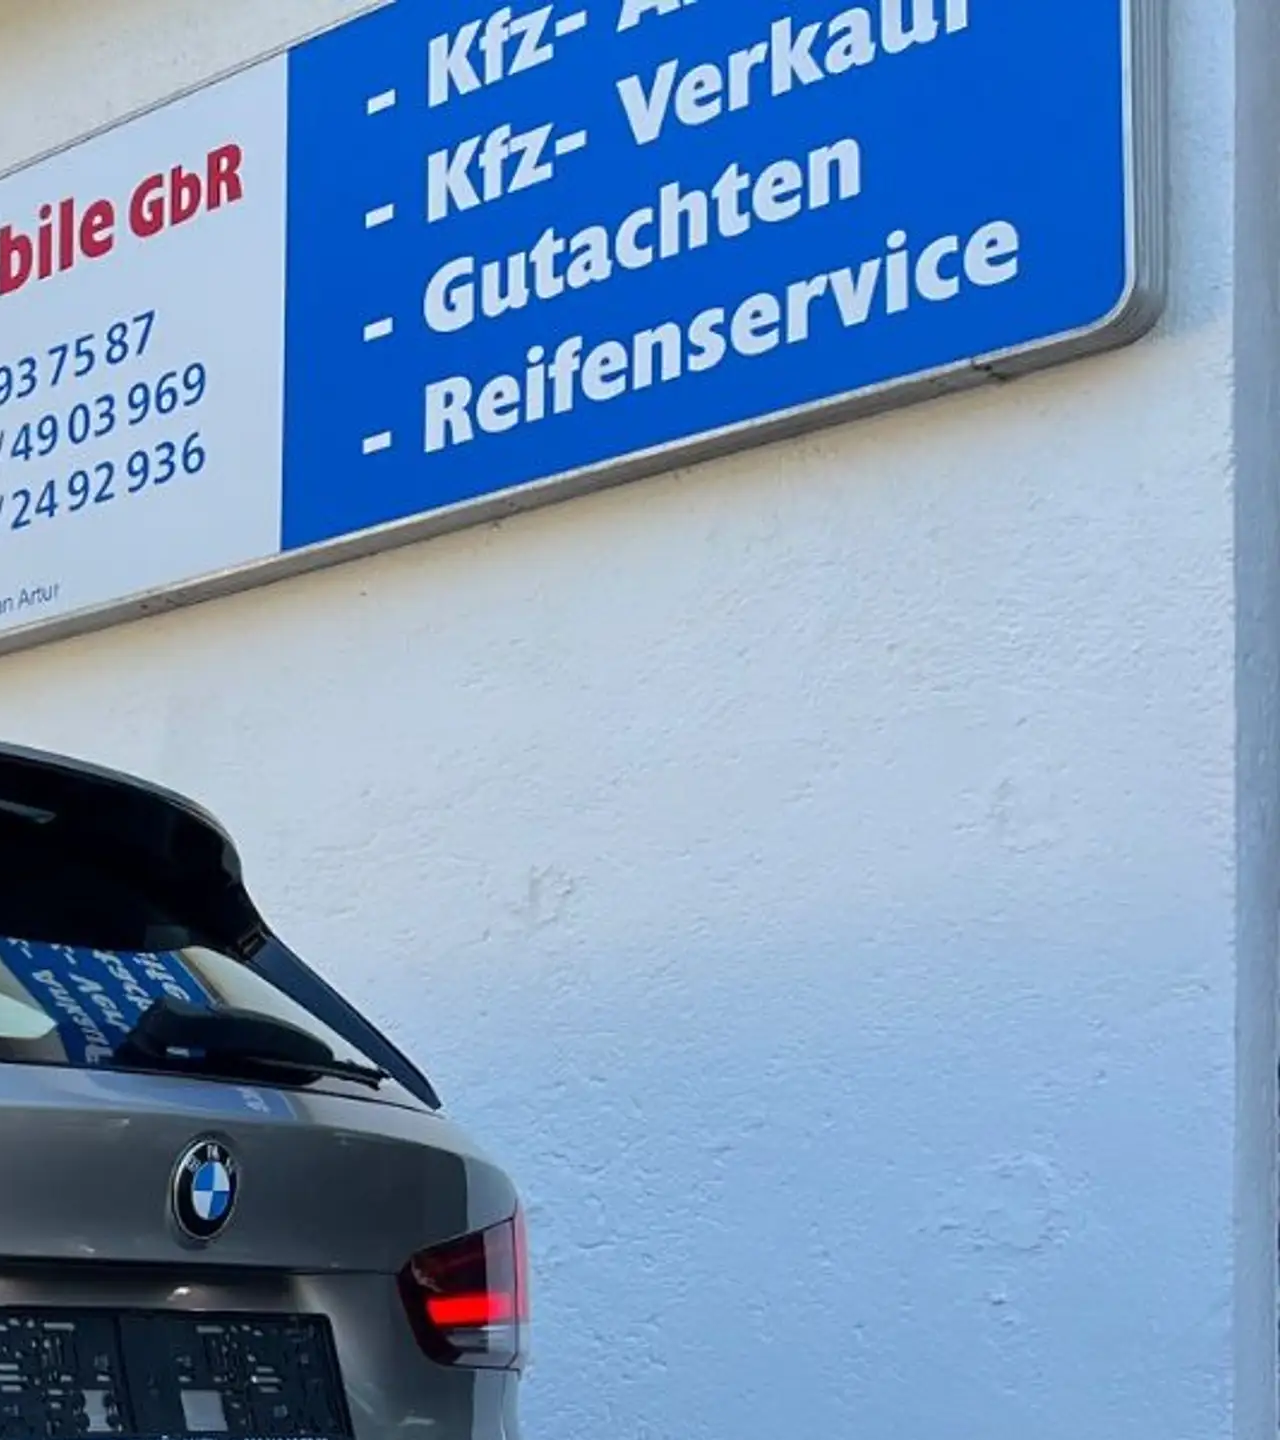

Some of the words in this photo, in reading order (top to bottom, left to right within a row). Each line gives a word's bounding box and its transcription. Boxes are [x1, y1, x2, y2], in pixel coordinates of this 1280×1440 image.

[428, 5, 586, 107] Kfz-
[129, 143, 243, 238] GbR
[427, 124, 586, 222] Kfz-
[424, 137, 860, 332] Gutachten
[425, 220, 1018, 453] Reifenservice
[18, 582, 60, 608] Artur
